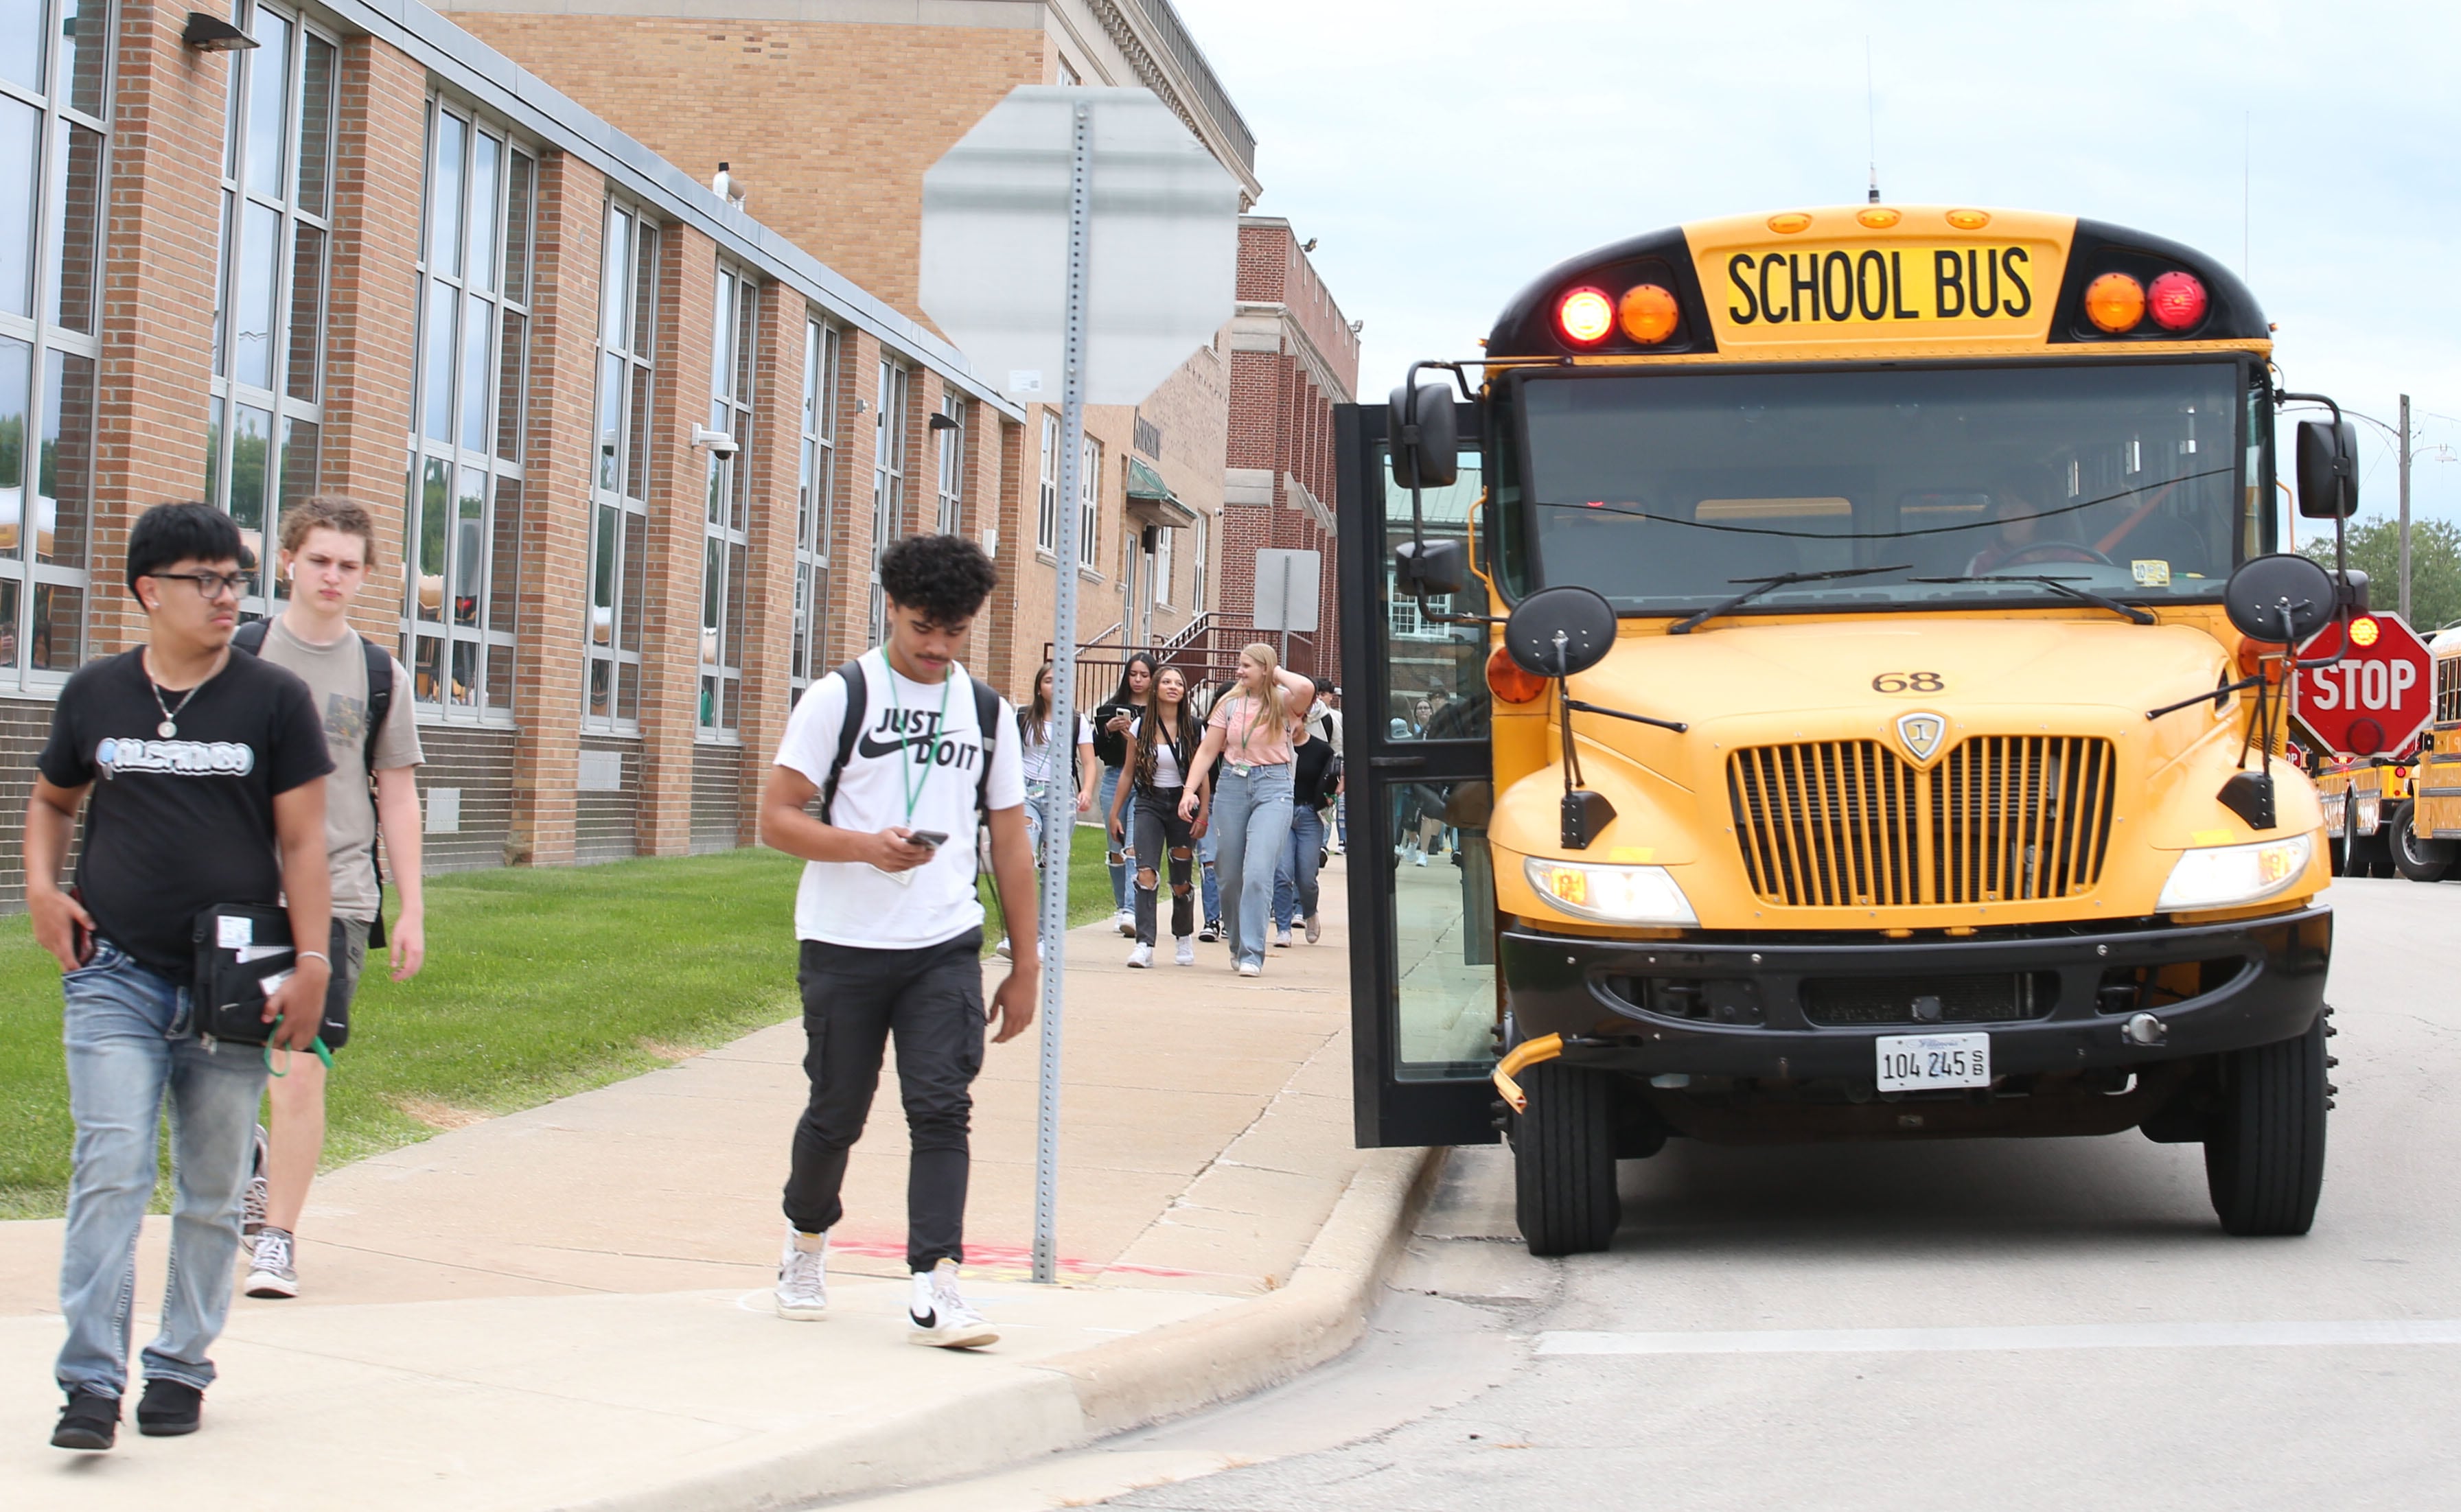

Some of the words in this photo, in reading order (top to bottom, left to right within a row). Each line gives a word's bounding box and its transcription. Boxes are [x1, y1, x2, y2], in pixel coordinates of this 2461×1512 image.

[1729, 249, 1919, 325] SCHOOL
[1934, 247, 2031, 318] BUS
[1872, 672, 1944, 693] 68
[2312, 659, 2416, 710] STOP
[875, 708, 943, 738] JUST
[915, 741, 955, 767] DO
[956, 743, 979, 771] IT
[1884, 1053, 1921, 1079] 104
[1928, 1051, 1965, 1077] 245
